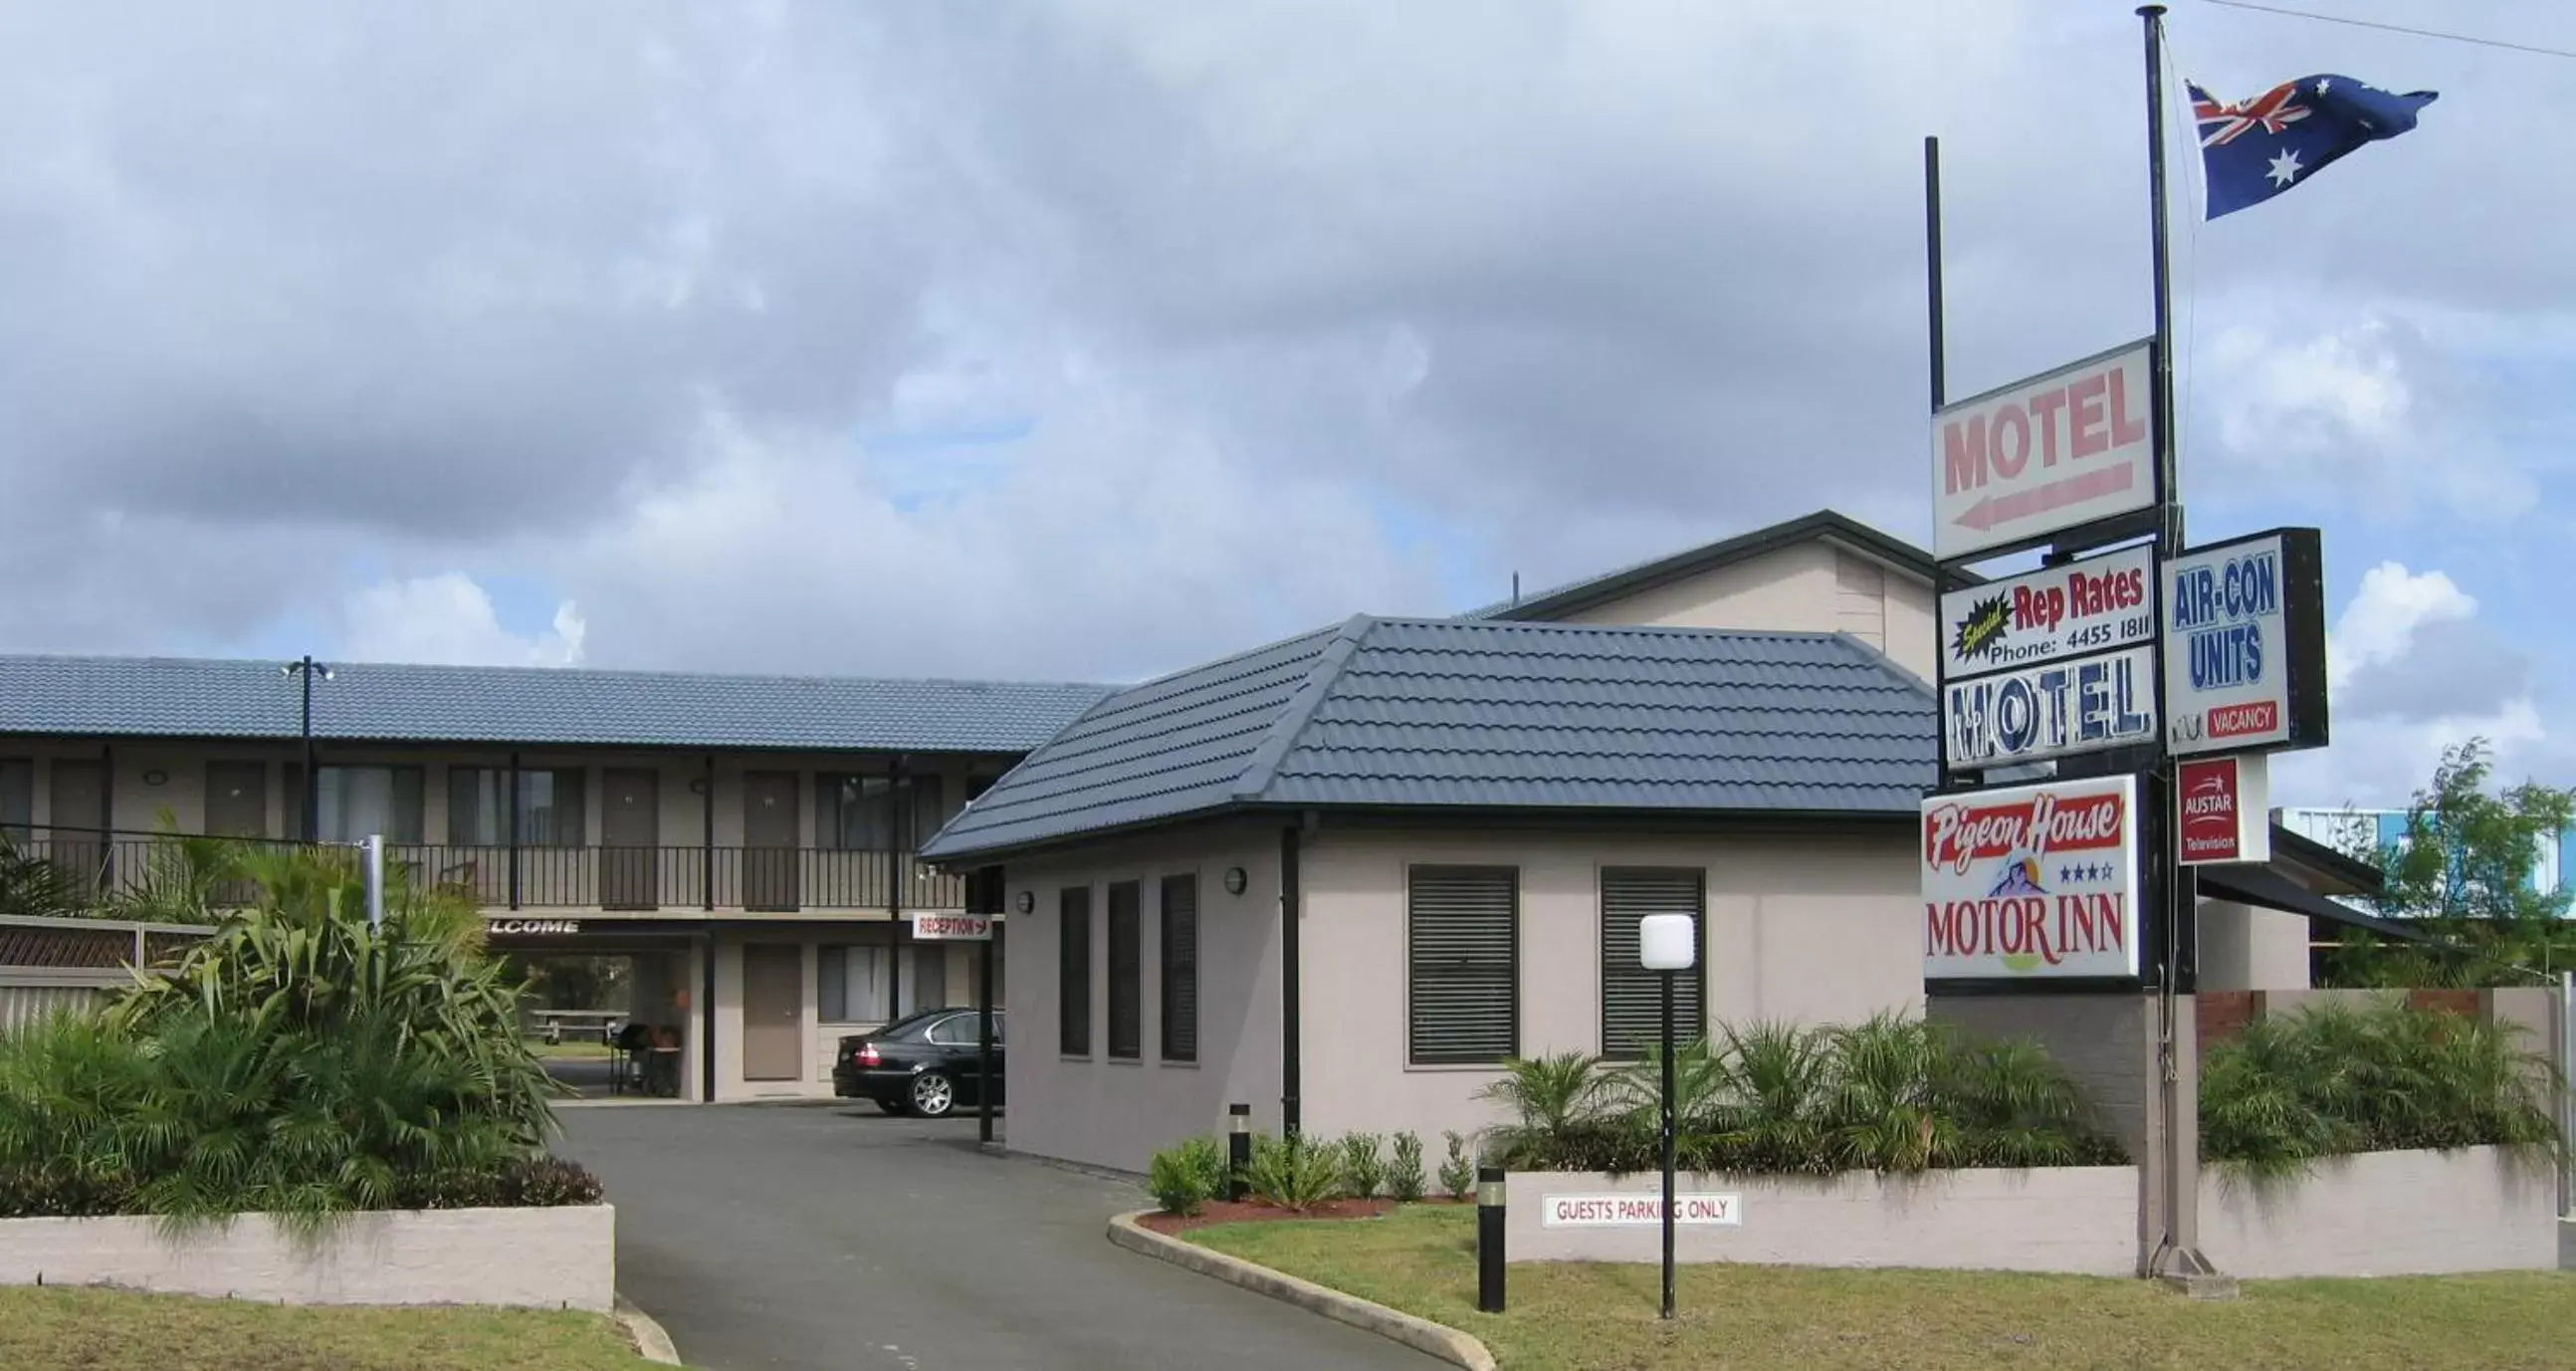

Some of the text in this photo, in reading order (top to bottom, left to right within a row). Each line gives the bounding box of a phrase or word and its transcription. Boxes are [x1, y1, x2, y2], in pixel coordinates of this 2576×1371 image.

[1944, 366, 2146, 496] MOTEL
[2013, 567, 2144, 633] Rep Rates
[2174, 553, 2276, 629] AIR-CON
[1991, 614, 2150, 664] Phone: 4455 1811
[2190, 623, 2261, 689] UNITS
[1946, 655, 2151, 760] MOTEL
[2213, 705, 2272, 733] VACANCY
[2185, 794, 2232, 815] AUSTAR
[1928, 793, 2124, 876] Pigeon House
[2186, 835, 2236, 851] Television
[487, 919, 580, 935] LCOME
[919, 917, 974, 936] RECEPTION
[1925, 892, 2124, 965] MOTOR INN
[1556, 1200, 1729, 1221] GUESTS PARKIG ONLY
